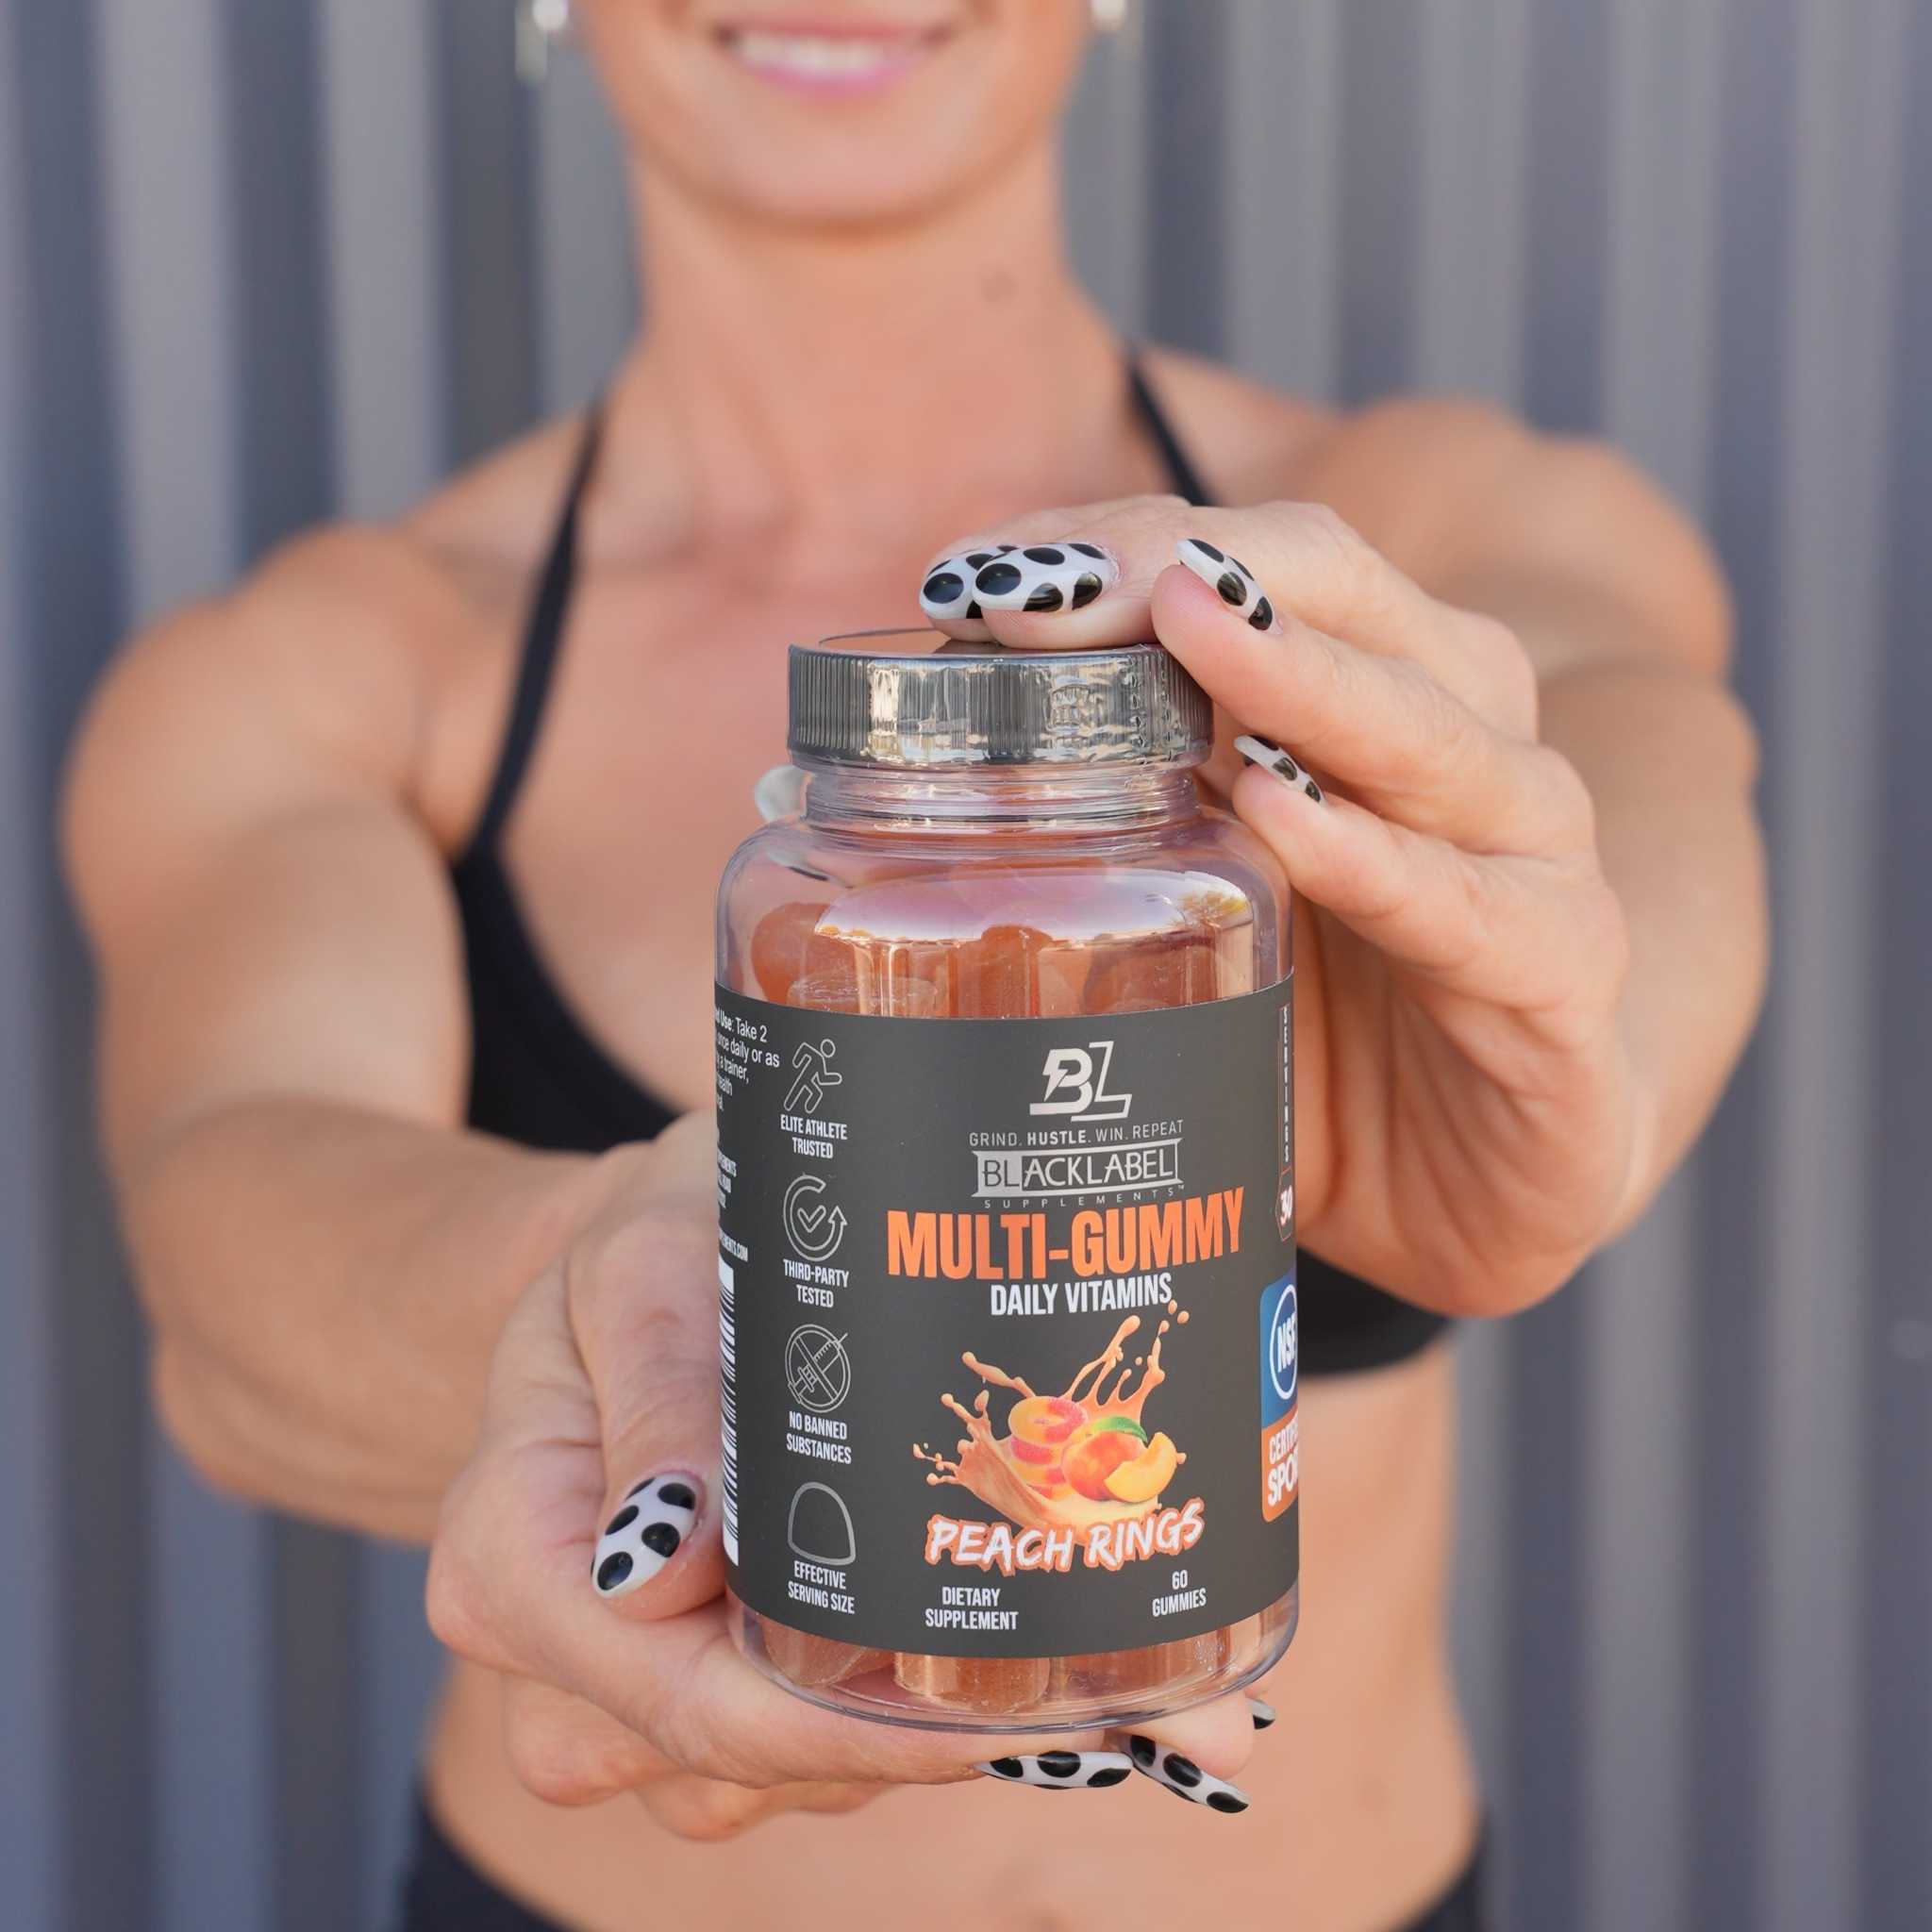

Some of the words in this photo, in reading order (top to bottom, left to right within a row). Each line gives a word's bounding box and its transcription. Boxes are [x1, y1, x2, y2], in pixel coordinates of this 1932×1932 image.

[735, 1017, 758, 1041] Take
[759, 1025, 768, 1043] 2
[730, 1038, 750, 1063] daily
[752, 1049, 763, 1063] or
[765, 1052, 780, 1068] as
[724, 1057, 749, 1084] trainer,
[780, 1113, 804, 1133] ELITE
[805, 1118, 848, 1141] ATHLETE
[969, 1131, 1023, 1147] GRIND.
[1027, 1129, 1091, 1146] HUSTLE.
[1095, 1126, 1129, 1142] WIN.
[1132, 1119, 1184, 1139] REPEAT
[791, 1137, 834, 1159] TRUSTED
[887, 1186, 1245, 1280] MULTI-GUMMY
[783, 1258, 849, 1289] THIRD-PARTY
[796, 1284, 834, 1308] TESTED
[991, 1283, 1058, 1316] DAILY
[1065, 1272, 1174, 1314] VITAMINS
[789, 1411, 803, 1431] NO
[804, 1415, 848, 1441] BANNED
[786, 1433, 852, 1465] SUBSTANCES
[924, 1514, 1074, 1577] PEACH
[1084, 1496, 1206, 1572] RINGS
[793, 1560, 847, 1591] EFFECTIVE
[1172, 1569, 1189, 1591] 60
[788, 1580, 829, 1609] SERVING
[830, 1594, 856, 1615] SIZE
[941, 1586, 1001, 1608] DIETARY
[1152, 1588, 1208, 1618] GUMMIES
[924, 1608, 1019, 1631] SUPPLEMENT
